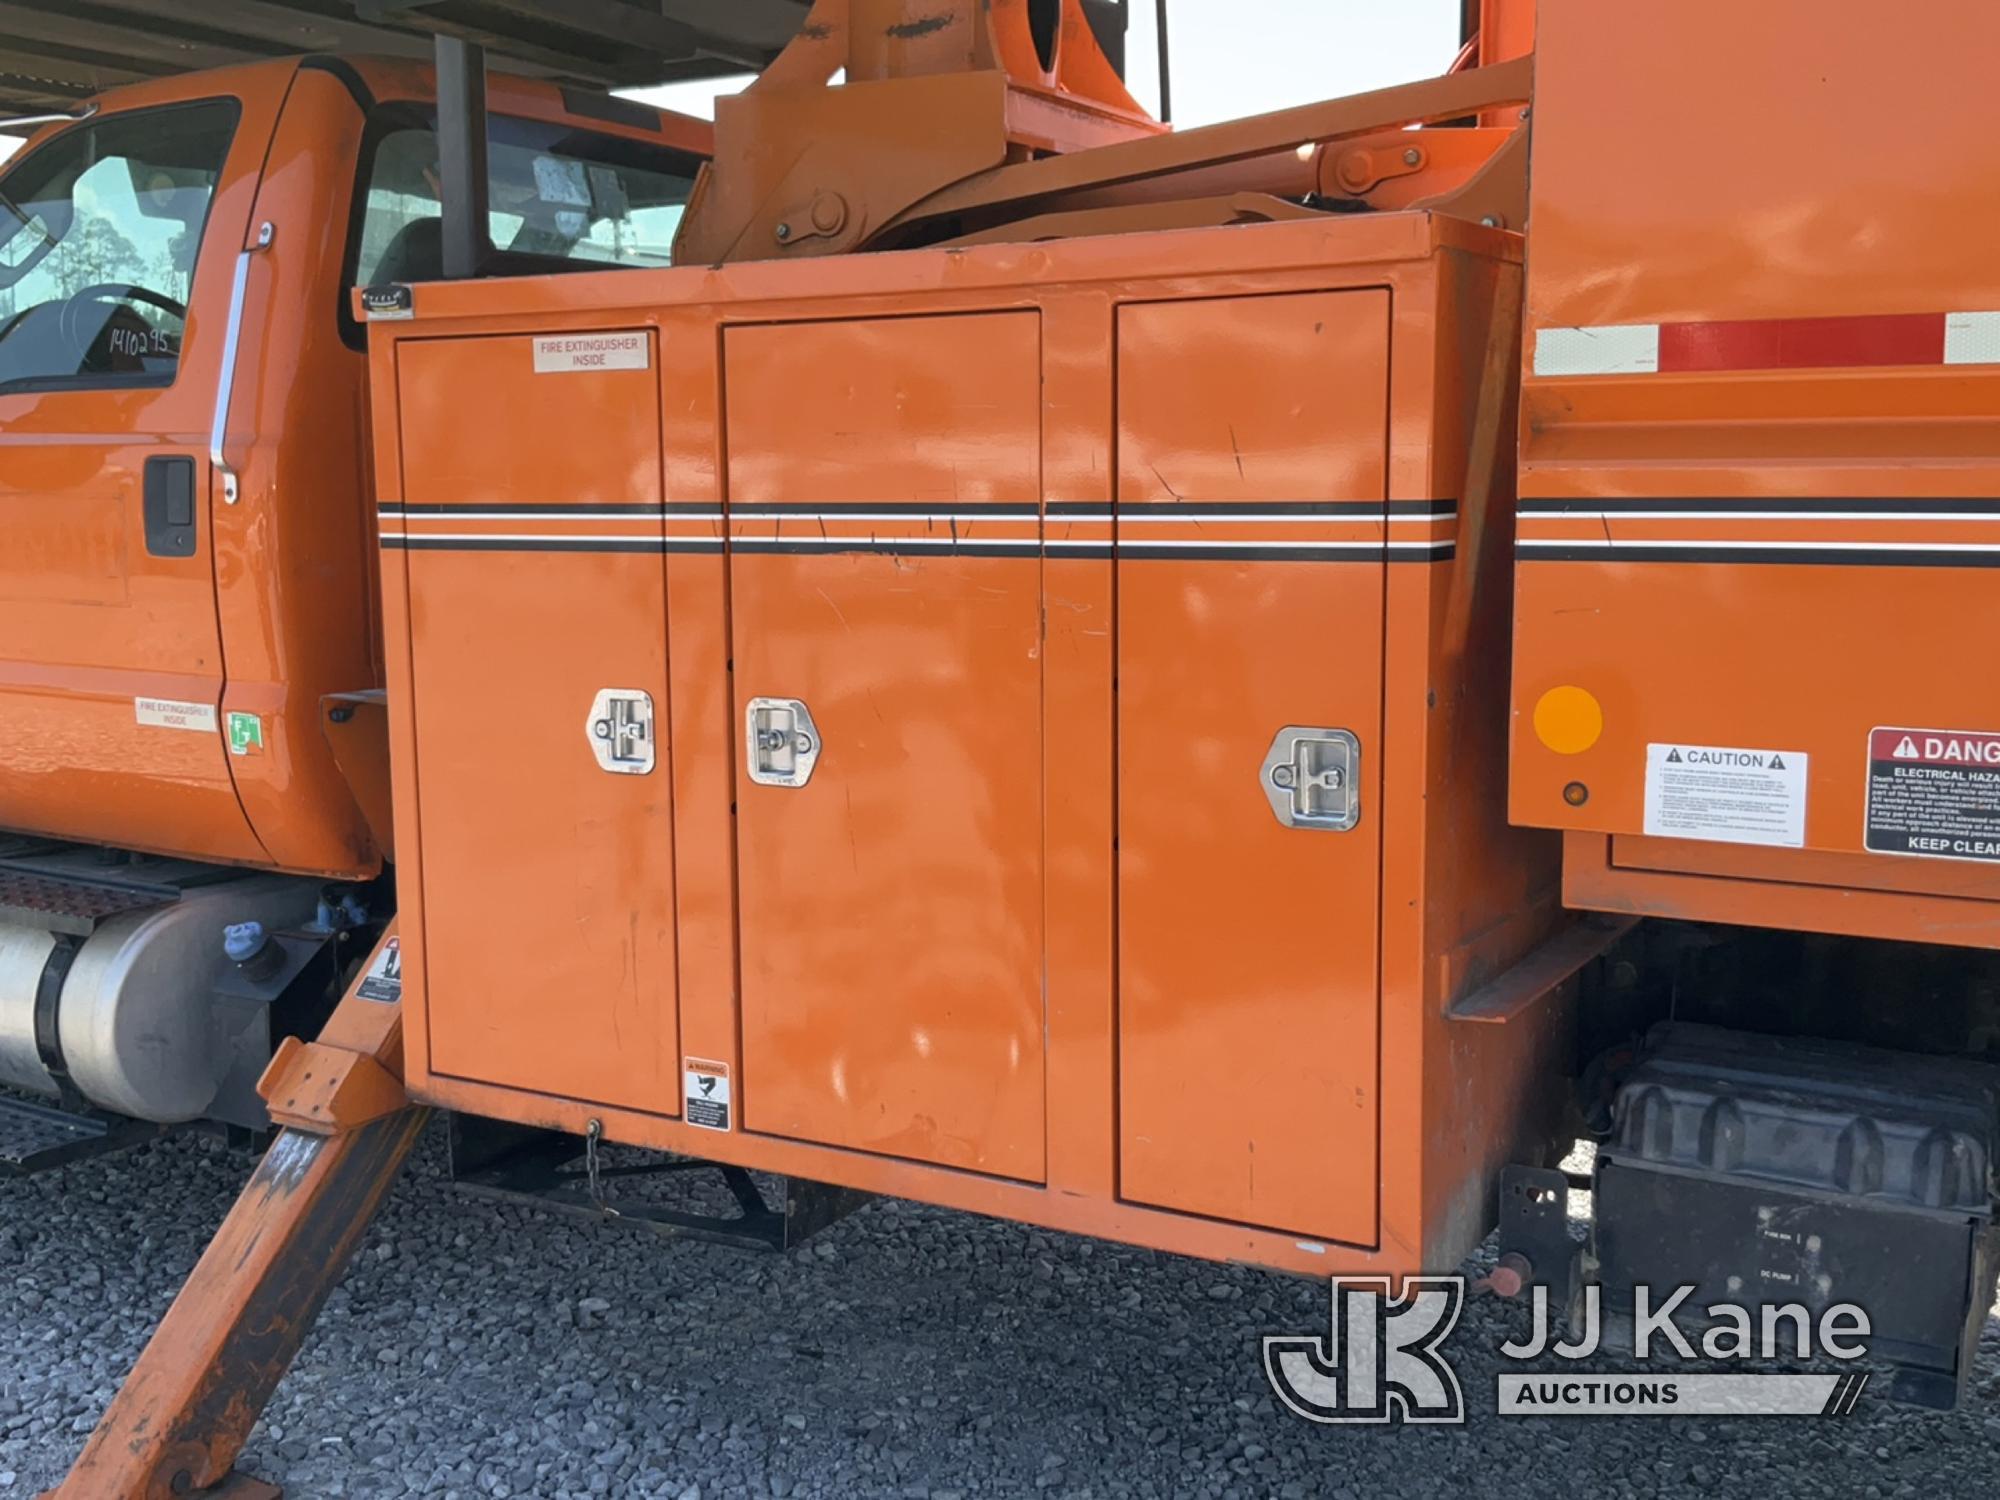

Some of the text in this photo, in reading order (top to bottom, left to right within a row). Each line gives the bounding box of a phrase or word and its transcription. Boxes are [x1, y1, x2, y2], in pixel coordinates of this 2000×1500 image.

[109, 328, 169, 356] 1410295
[541, 338, 639, 353] FIRE EXTINGUISHER
[572, 354, 606, 366] INSIDE
[140, 701, 209, 717] FIRE EXTINGUISHER
[163, 714, 187, 726] INSIDE
[1687, 750, 1764, 767] CAUTION
[1894, 767, 1966, 781] ELECTRICAL
[1908, 836, 1950, 850] KEEP
